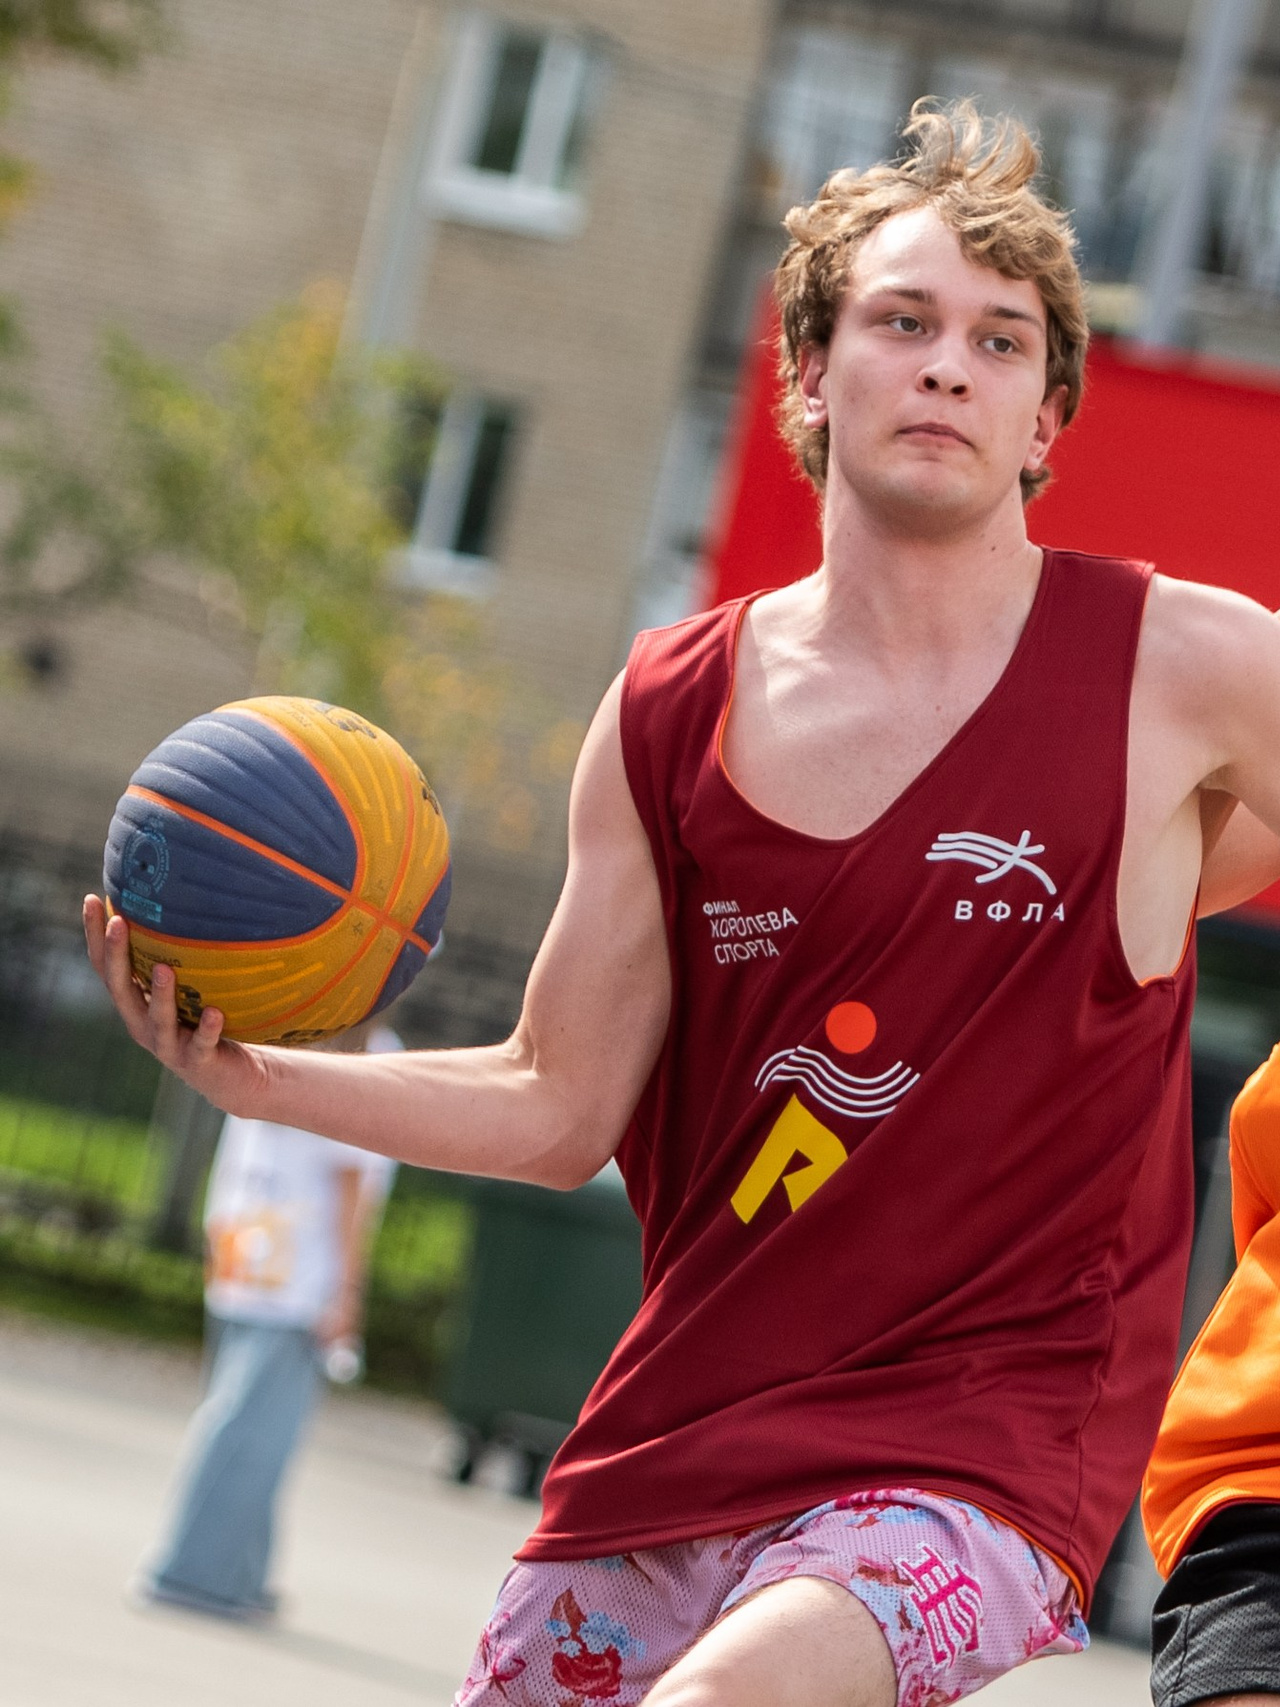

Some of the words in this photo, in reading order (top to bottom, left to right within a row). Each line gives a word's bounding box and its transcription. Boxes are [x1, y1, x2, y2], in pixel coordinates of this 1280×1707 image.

[702, 900, 741, 916] ФИНАЛ
[954, 899, 1065, 922] ВФЛА
[710, 907, 799, 938] КОРОЛЕВА
[714, 938, 780, 964] СПОРТА
